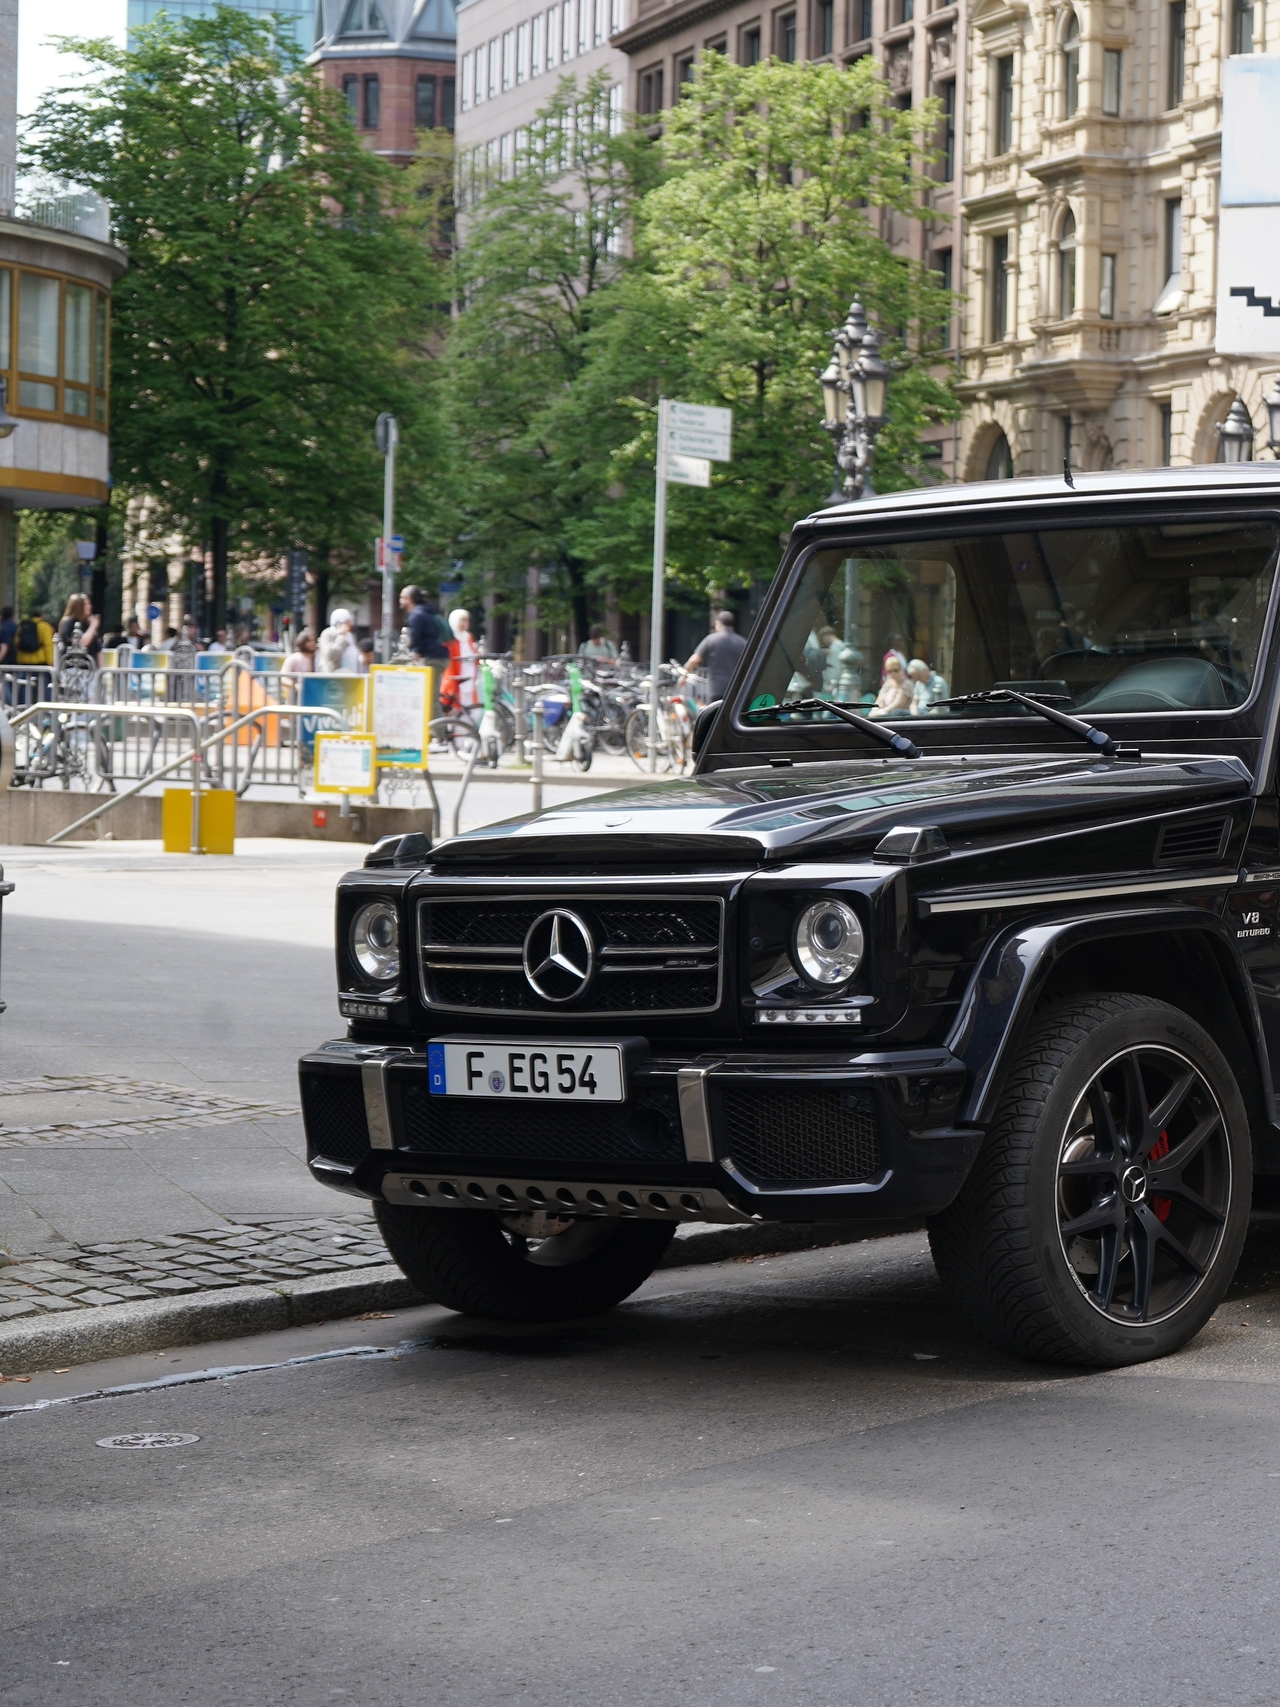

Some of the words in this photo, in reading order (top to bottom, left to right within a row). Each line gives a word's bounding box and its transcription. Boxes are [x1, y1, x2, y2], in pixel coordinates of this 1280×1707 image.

[758, 694, 768, 708] 4
[1260, 872, 1280, 880] AMG
[1241, 911, 1260, 925] V8
[1236, 927, 1271, 938] BITURBO
[466, 1051, 485, 1091] F
[433, 1074, 442, 1086] D
